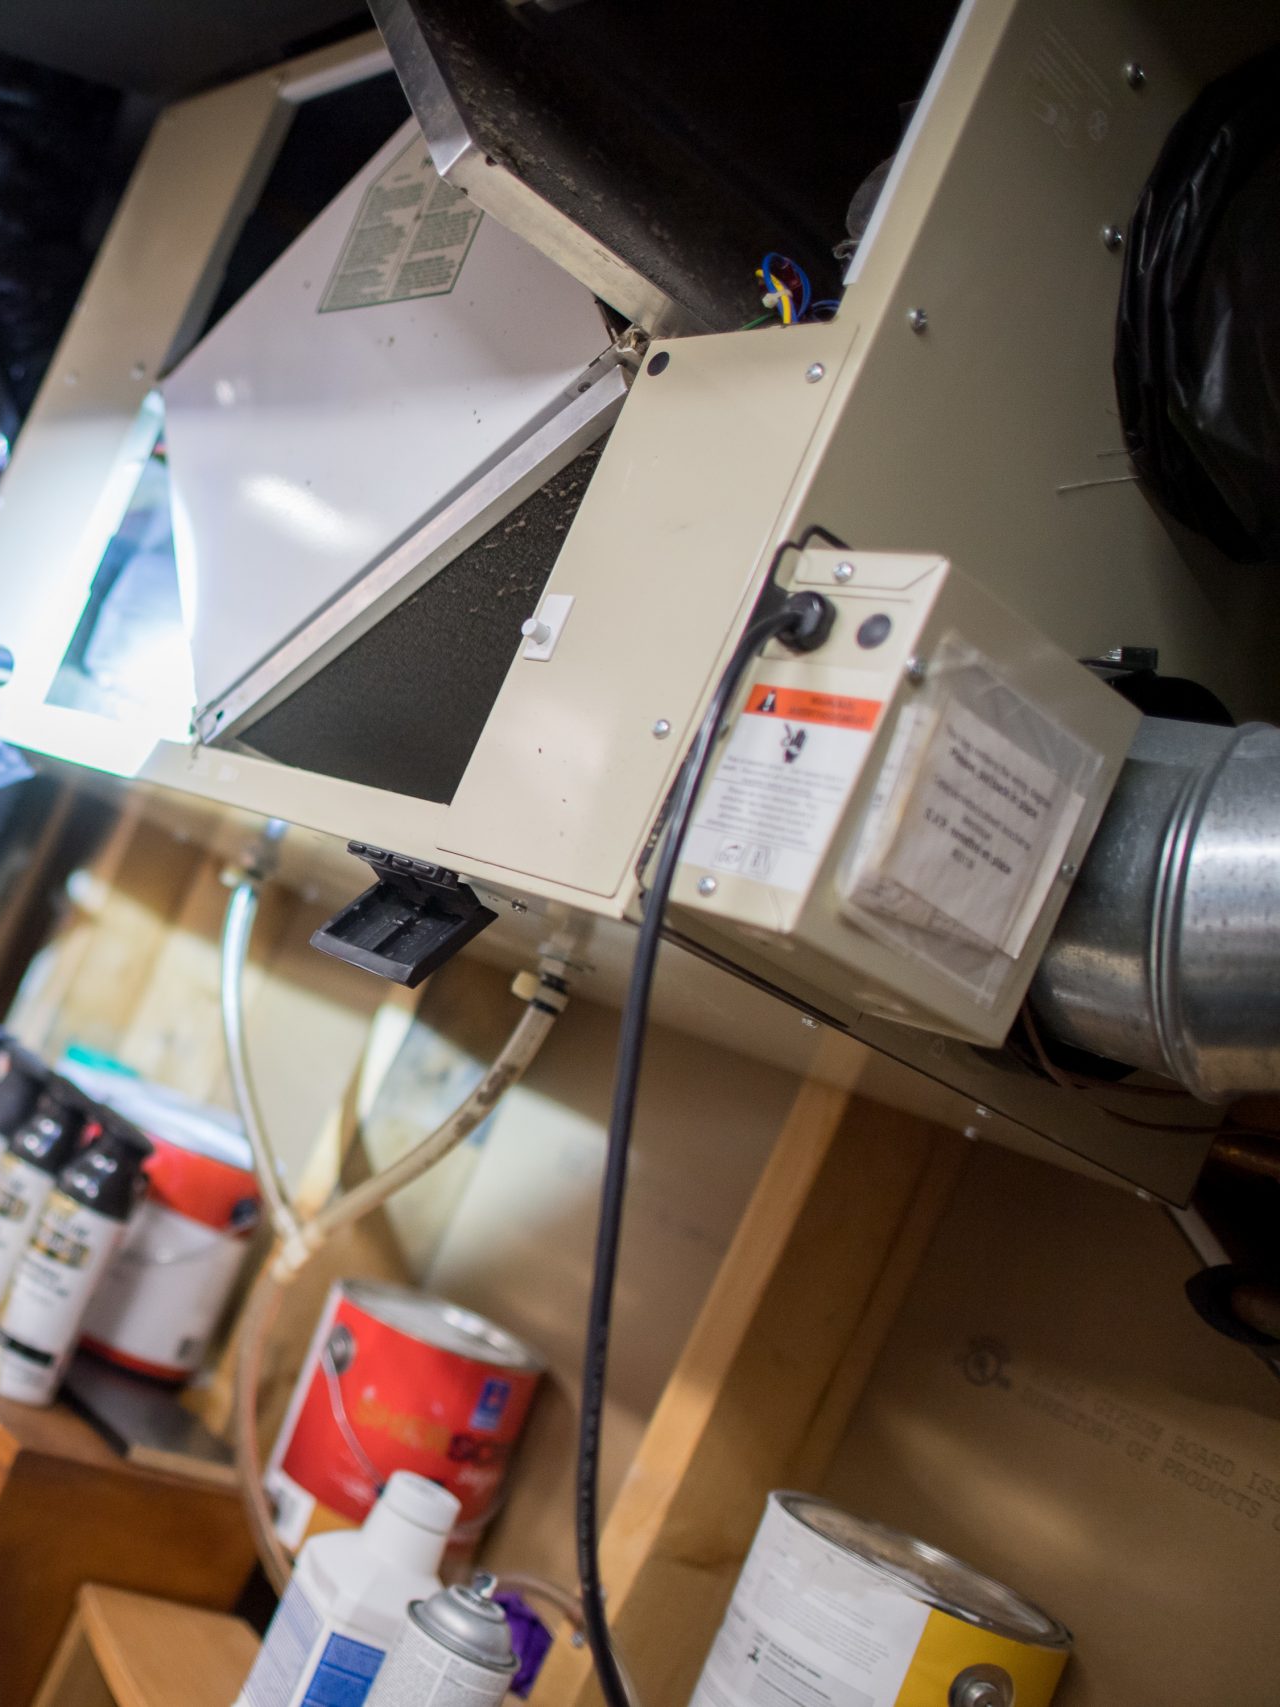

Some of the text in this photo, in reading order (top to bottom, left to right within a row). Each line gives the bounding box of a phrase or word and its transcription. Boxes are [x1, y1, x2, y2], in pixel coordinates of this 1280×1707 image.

[1126, 1439, 1155, 1463] OF
[1159, 1456, 1263, 1519] PRODUCTS
[1172, 1435, 1235, 1477] BOARD
